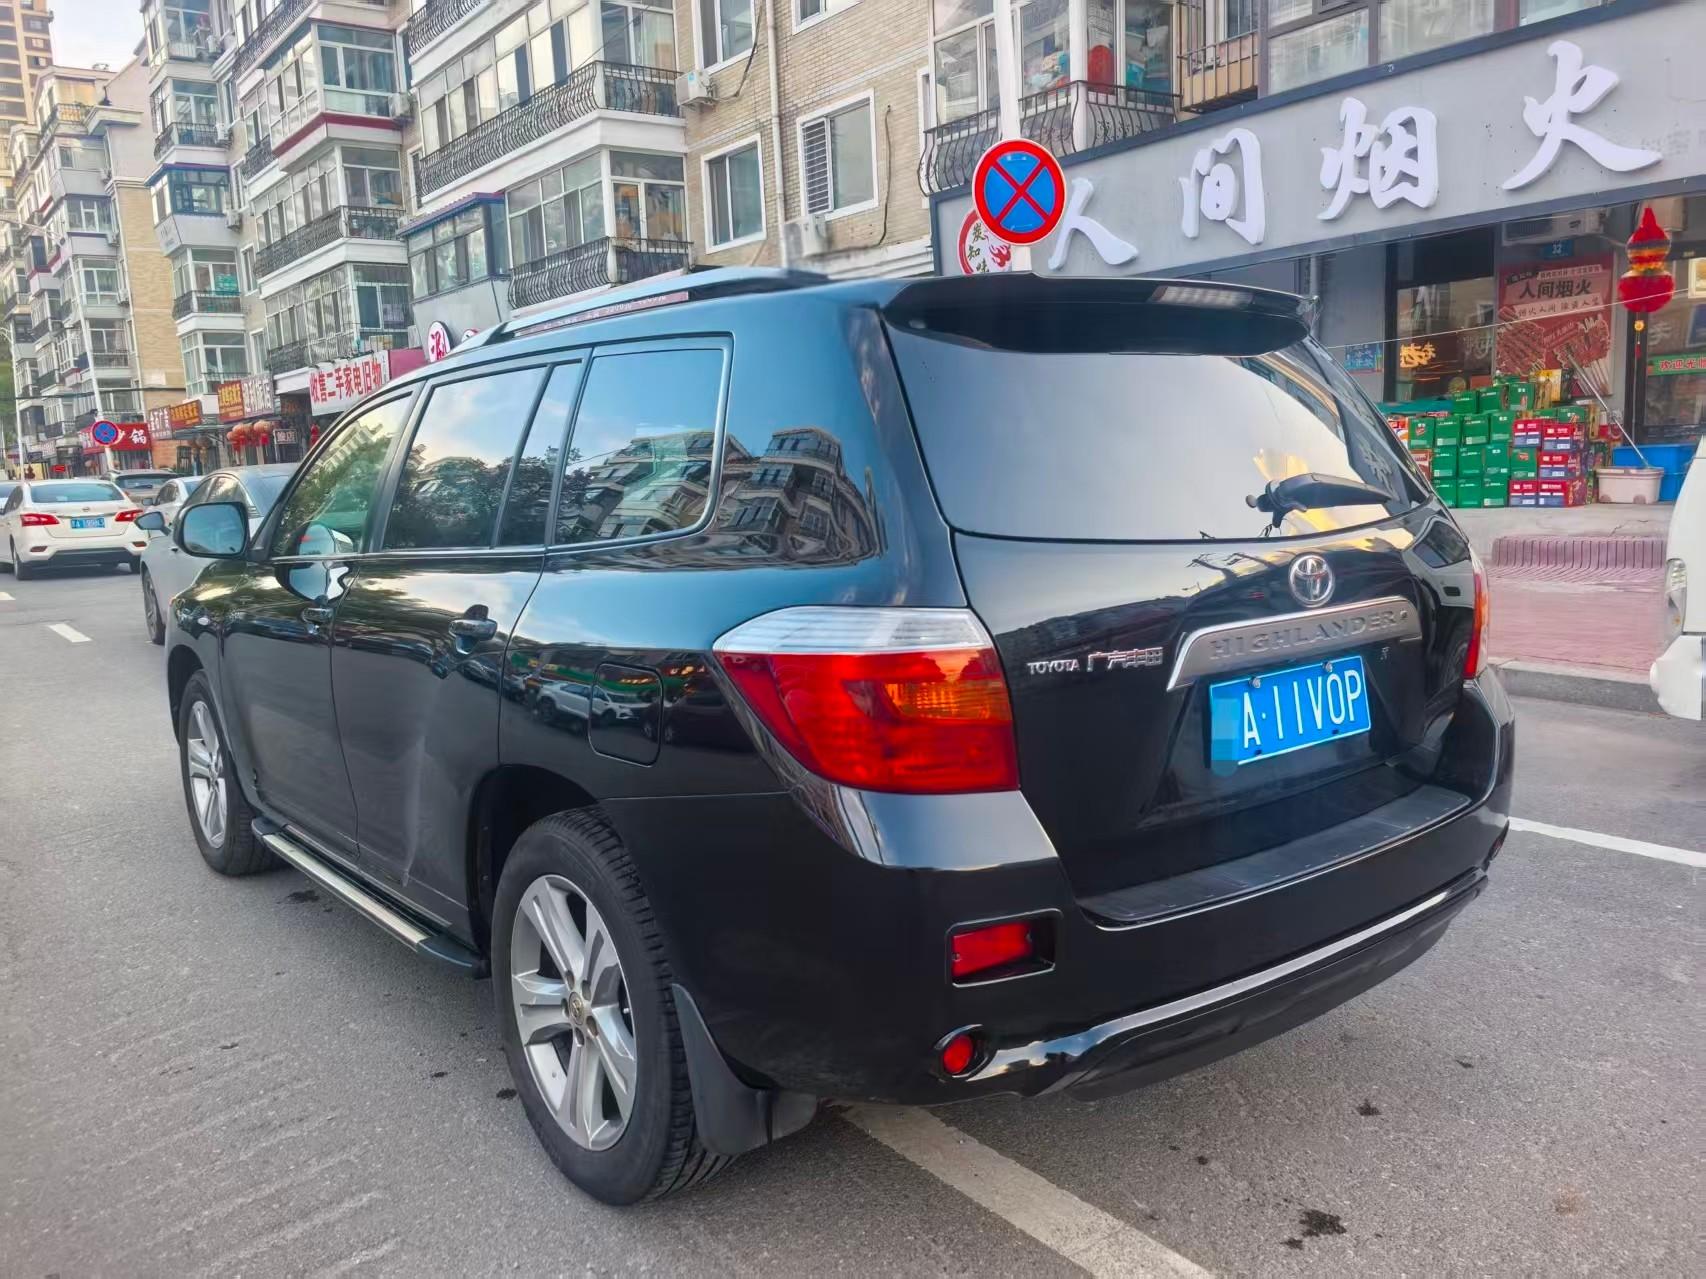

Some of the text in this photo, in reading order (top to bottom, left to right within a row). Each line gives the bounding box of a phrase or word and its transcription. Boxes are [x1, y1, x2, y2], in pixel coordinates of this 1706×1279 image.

[1048, 41, 1663, 270] 人间烟火
[1519, 278, 1593, 299] 人间烟火
[309, 356, 384, 404] 收售二手家电旧物
[1209, 609, 1397, 661] HIGHLANDER
[1027, 658, 1080, 675] TOYOTA
